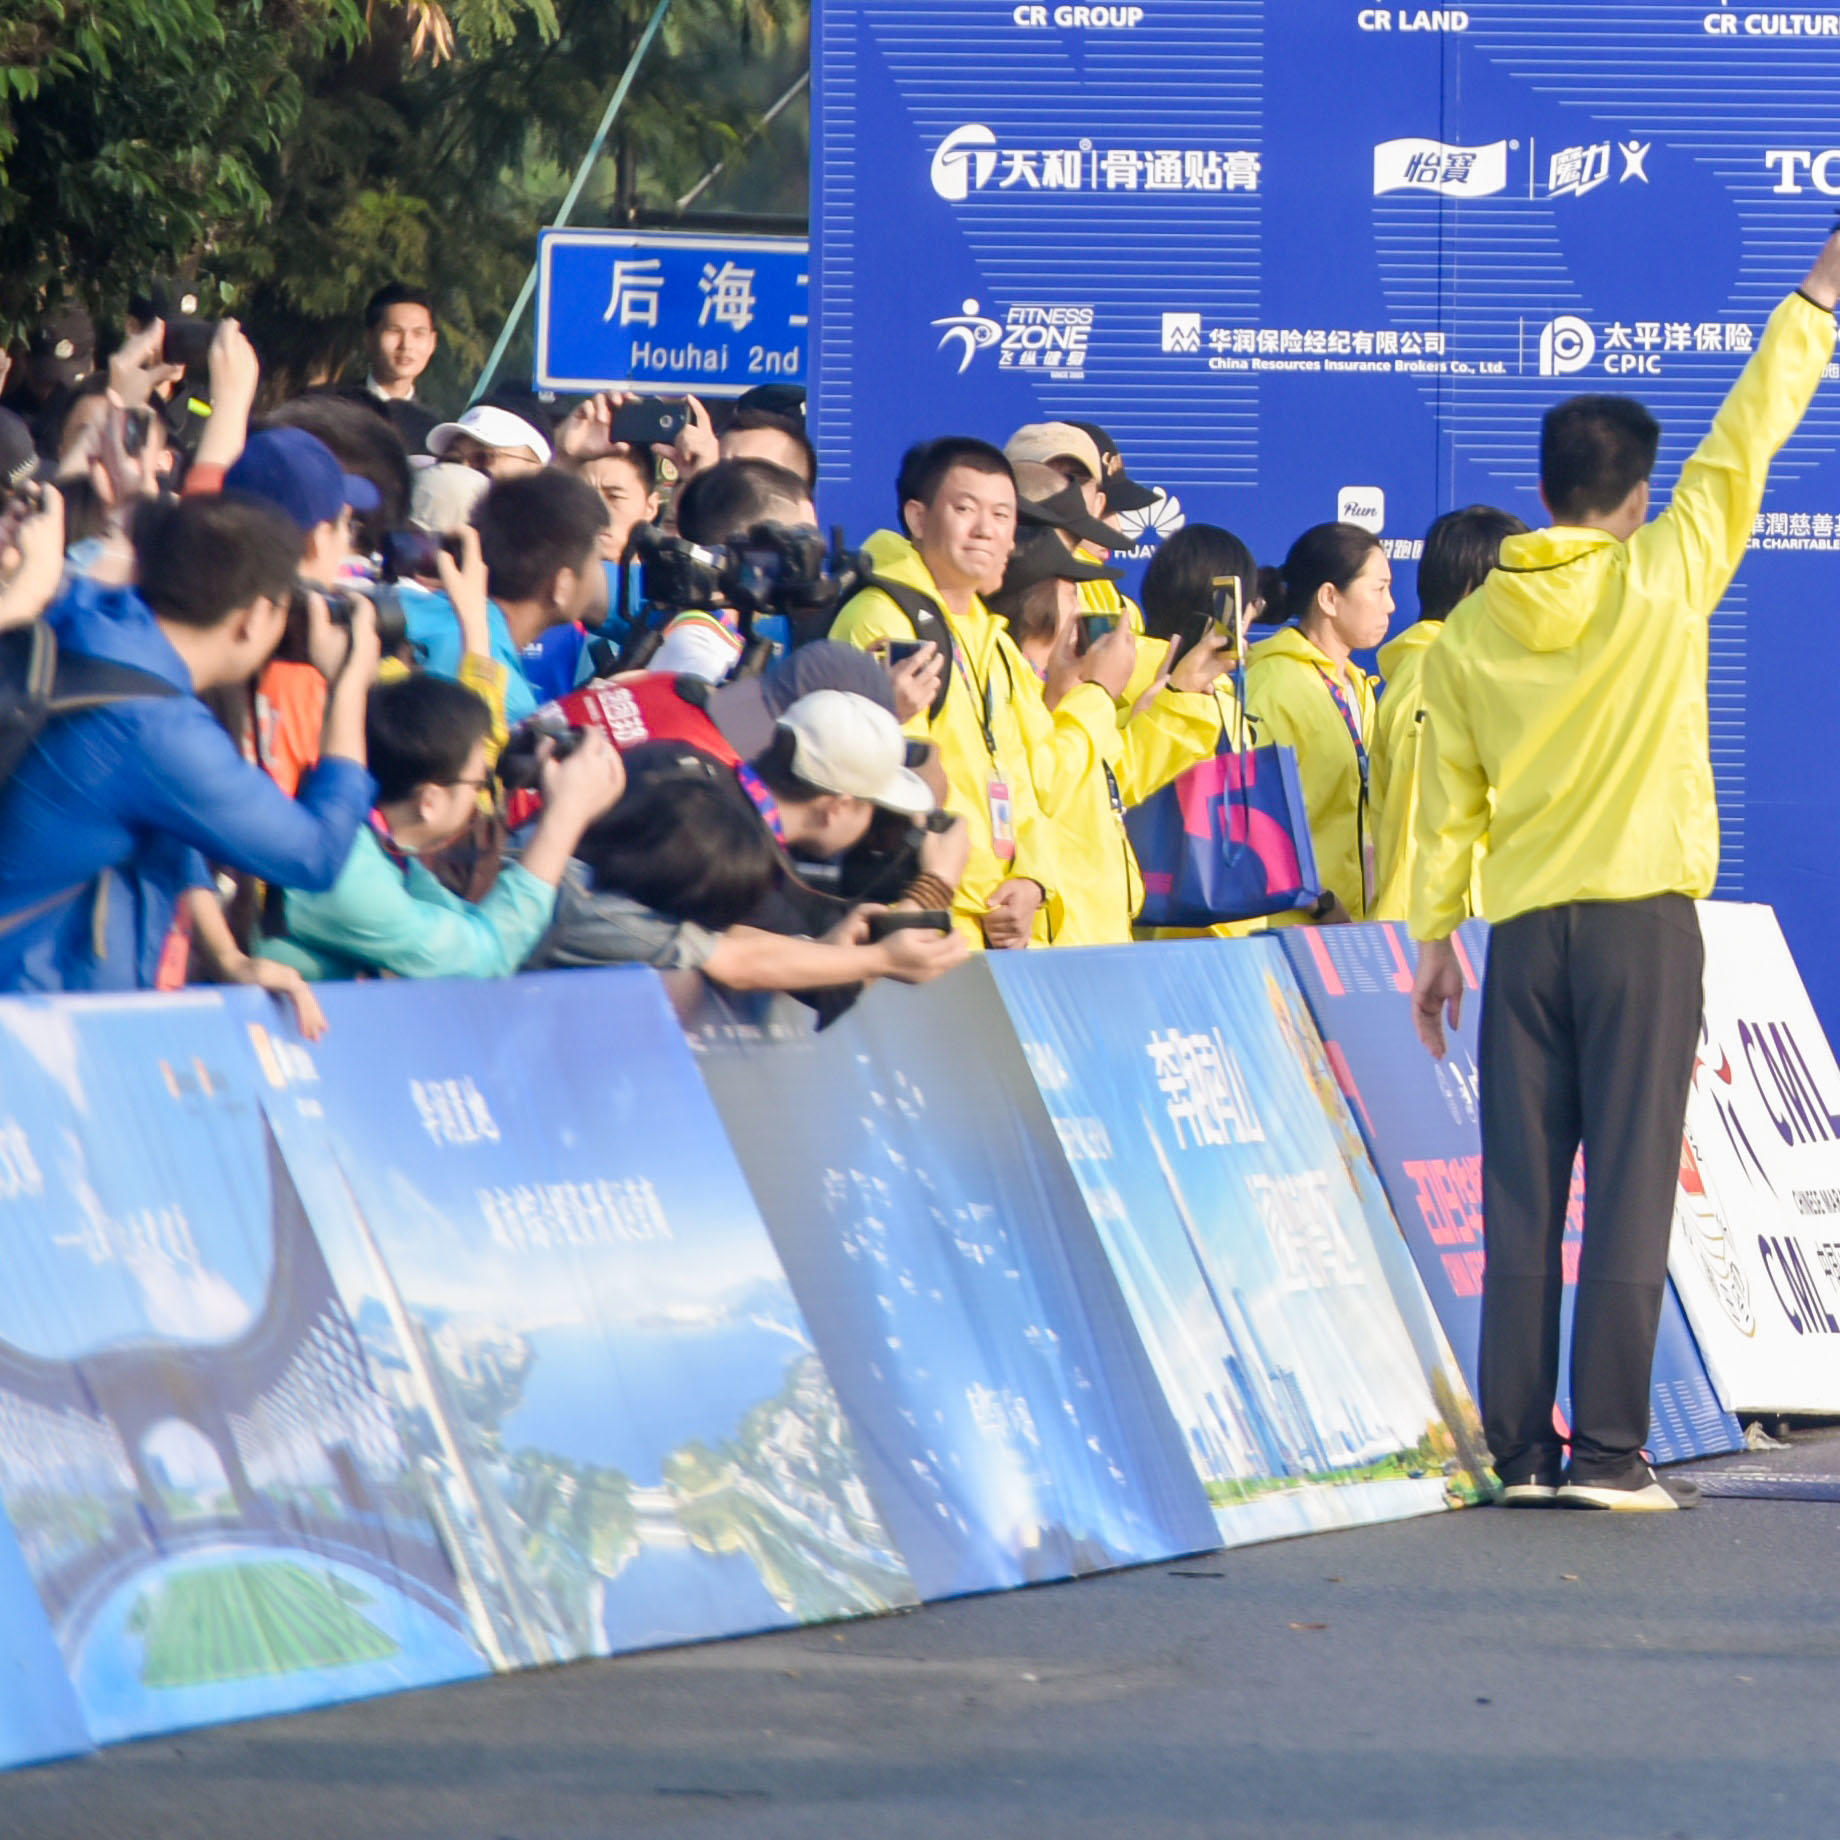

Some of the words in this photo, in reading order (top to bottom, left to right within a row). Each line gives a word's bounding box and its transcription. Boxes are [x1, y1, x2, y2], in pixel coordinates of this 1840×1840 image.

[1013, 5, 1047, 27] CR
[1054, 6, 1144, 28] GROUP
[1357, 9, 1392, 31] CR
[1398, 10, 1469, 31] LAND
[1704, 13, 1738, 35] CR
[1007, 307, 1094, 324] FITNESS
[1001, 325, 1092, 350] ZONE
[1208, 329, 1446, 355] 华润保险经纪有限公司
[1604, 322, 1753, 352] 太平洋保险
[631, 341, 728, 372] Houhai
[748, 345, 800, 374] 2nd
[1209, 358, 1248, 370] China
[1252, 358, 1320, 371] Resources
[1324, 359, 1392, 372] Insurance
[1395, 360, 1447, 373] Brokers
[1479, 361, 1507, 374] Ltd.
[1604, 355, 1661, 374] CPIC
[1343, 501, 1378, 517] Run
[1763, 538, 1840, 551] CHARITABLE
[1757, 1234, 1840, 1335] CML
